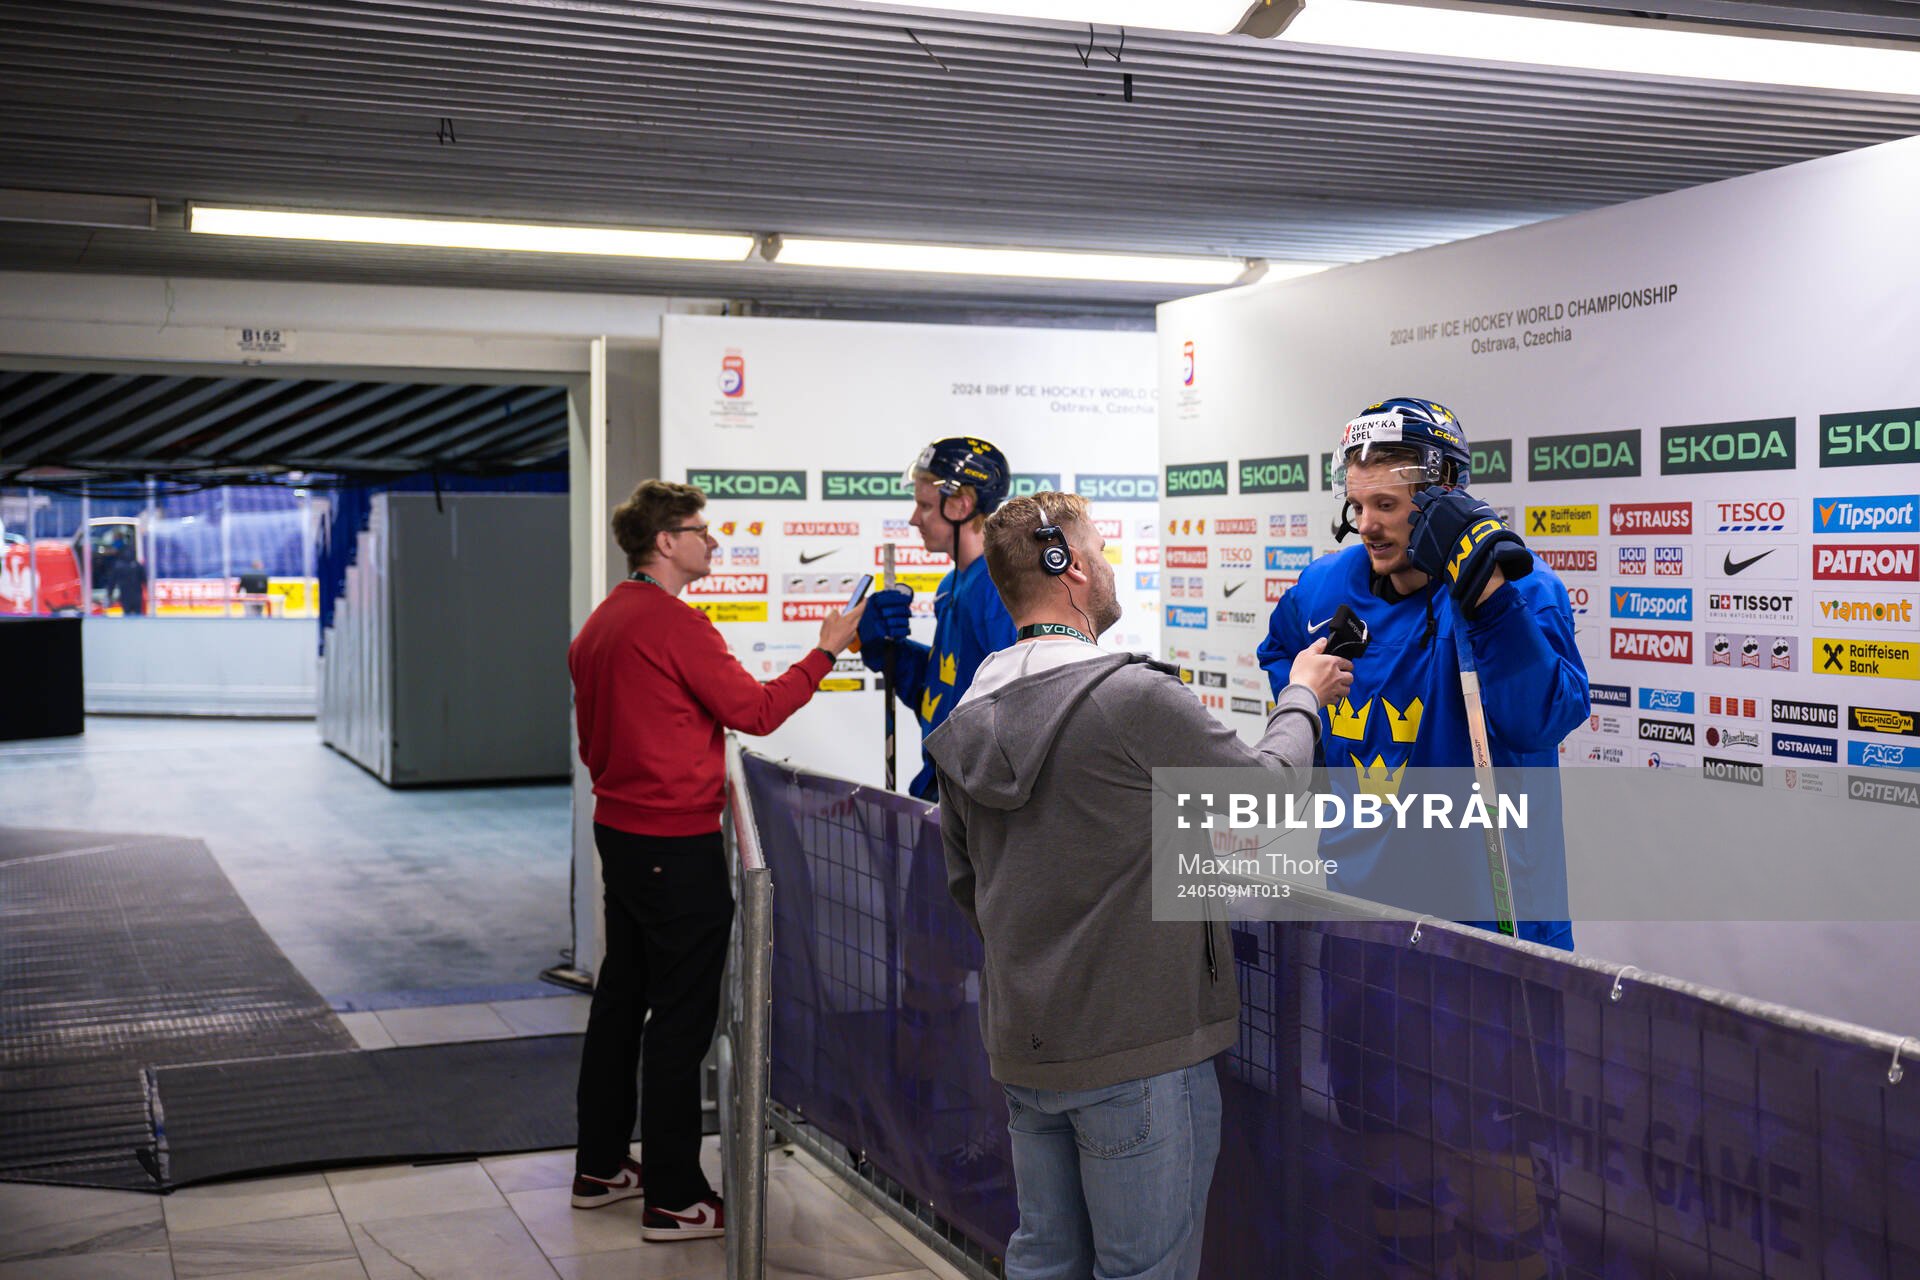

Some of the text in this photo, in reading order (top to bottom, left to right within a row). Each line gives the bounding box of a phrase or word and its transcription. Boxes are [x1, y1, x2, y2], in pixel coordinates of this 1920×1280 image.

[1390, 284, 1678, 345] 2024 IIHF ICE HOCKEY WORLD CHAMPIONSHIP
[1471, 326, 1572, 355] Ostrava, Czechia
[951, 383, 982, 396] 2024
[1015, 384, 1036, 397] ICE
[1041, 385, 1096, 398] HOCKEY
[1100, 387, 1148, 399] WORLD
[1351, 431, 1372, 443] SPEL
[1433, 429, 1459, 444] CCM
[1827, 421, 1920, 455] SKO
[1550, 508, 1591, 520] Raiffeisen
[1626, 509, 1689, 528] STRAUSS
[1717, 502, 1785, 522] TESCO
[1838, 502, 1913, 530] Tipsport
[784, 523, 859, 535] BAUHAUS
[1550, 522, 1571, 533] Bank
[1220, 548, 1253, 562] TESCO
[1447, 519, 1509, 583] CM
[1620, 548, 1646, 561] LIQUI
[1655, 548, 1682, 561] LIQUI
[1620, 561, 1646, 575] MOLY
[1655, 562, 1682, 575] MOLY
[1817, 550, 1914, 577] PATRON
[690, 576, 764, 592] PATRON
[1630, 593, 1687, 617] Tipsport
[1733, 595, 1792, 612] TISSOT
[1820, 599, 1912, 623] viamont
[1614, 632, 1689, 658] PATRON
[1850, 644, 1909, 660] Raiffeisen
[1850, 660, 1879, 674] Bank
[1589, 689, 1627, 702] STRAVA!!!
[1773, 704, 1837, 724] SAMSUNG
[1640, 723, 1693, 742] ORTEMA
[1777, 740, 1832, 756] OSTRAVA!!!
[1706, 761, 1761, 782] NOTINO
[1851, 781, 1919, 804] ORTEMA
